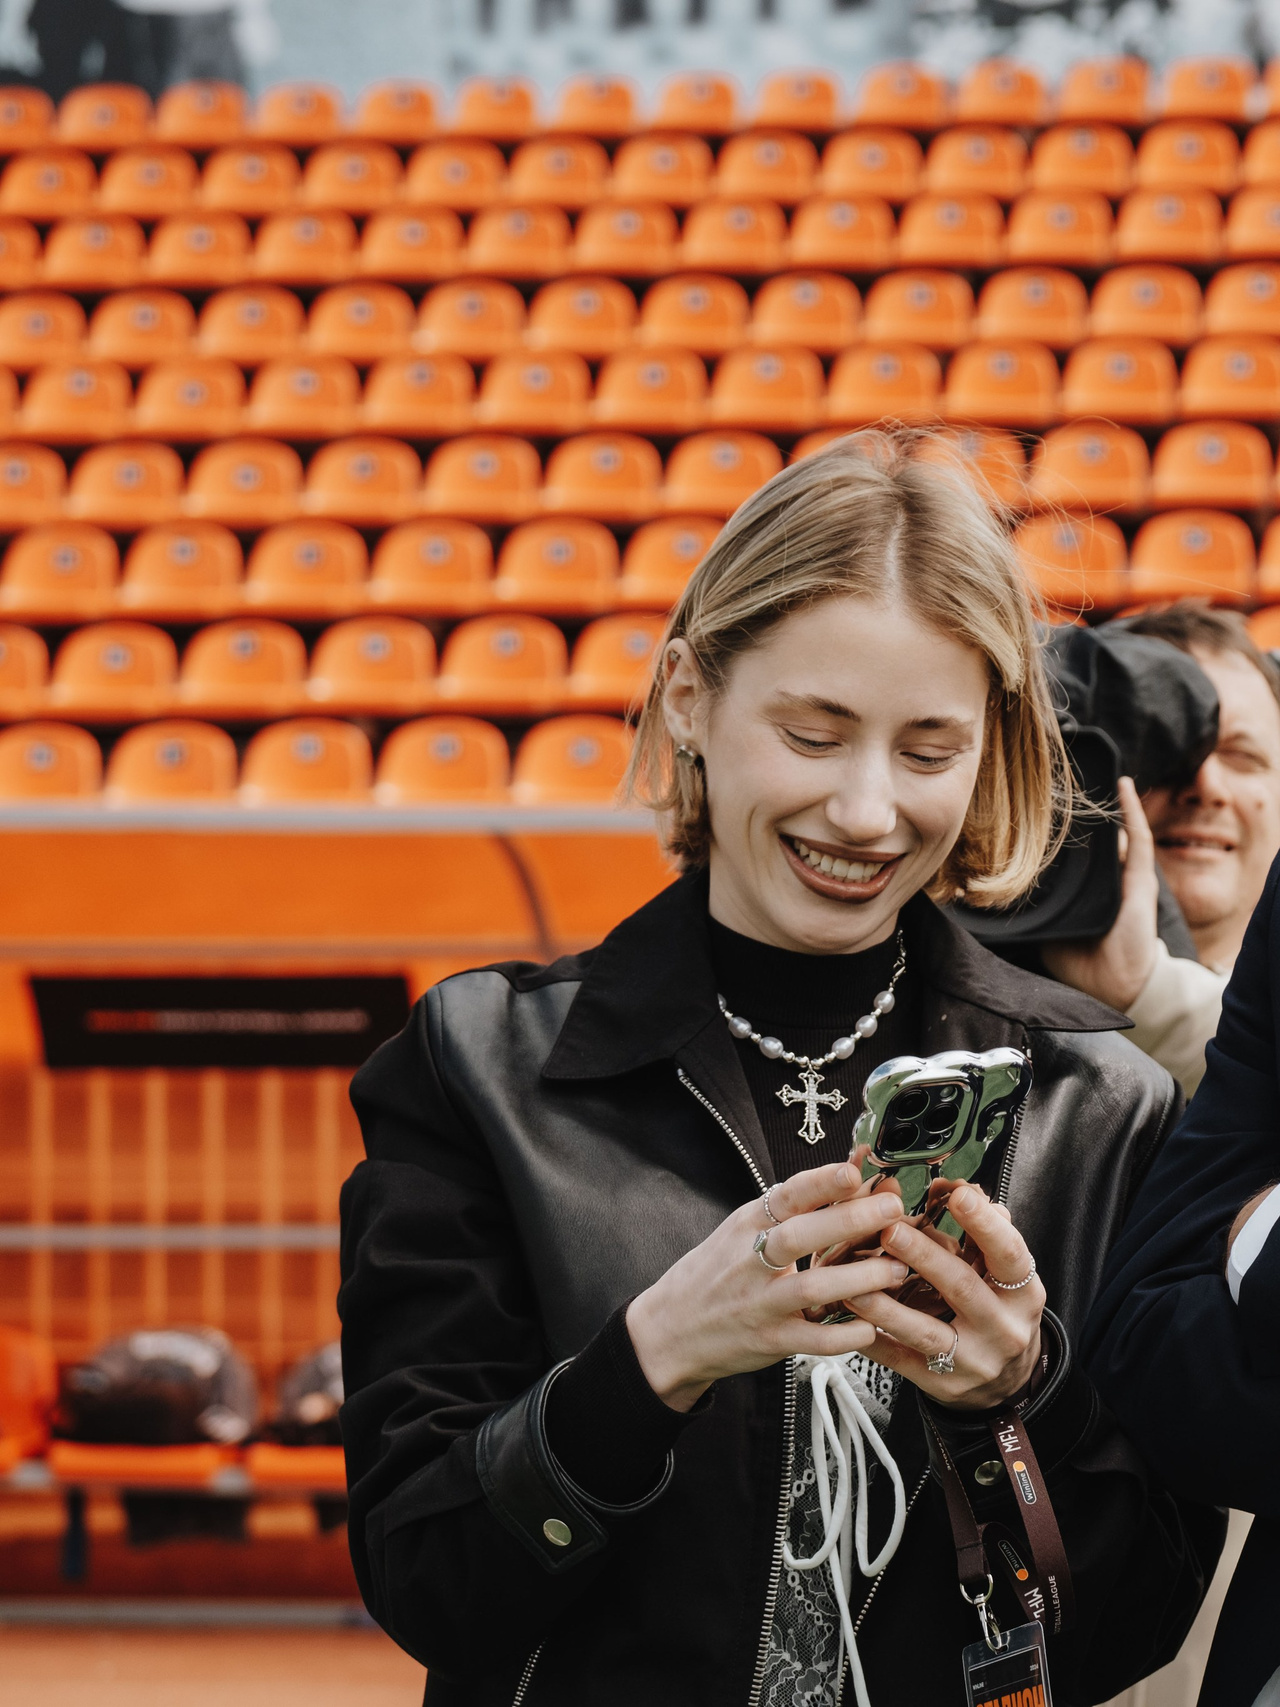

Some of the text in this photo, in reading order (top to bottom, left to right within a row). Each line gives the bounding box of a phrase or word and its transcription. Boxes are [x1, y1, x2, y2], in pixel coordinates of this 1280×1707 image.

[998, 1425, 1021, 1452] MFL
[1024, 1587, 1045, 1618] MFL
[1048, 1575, 1061, 1609] LEAGUE
